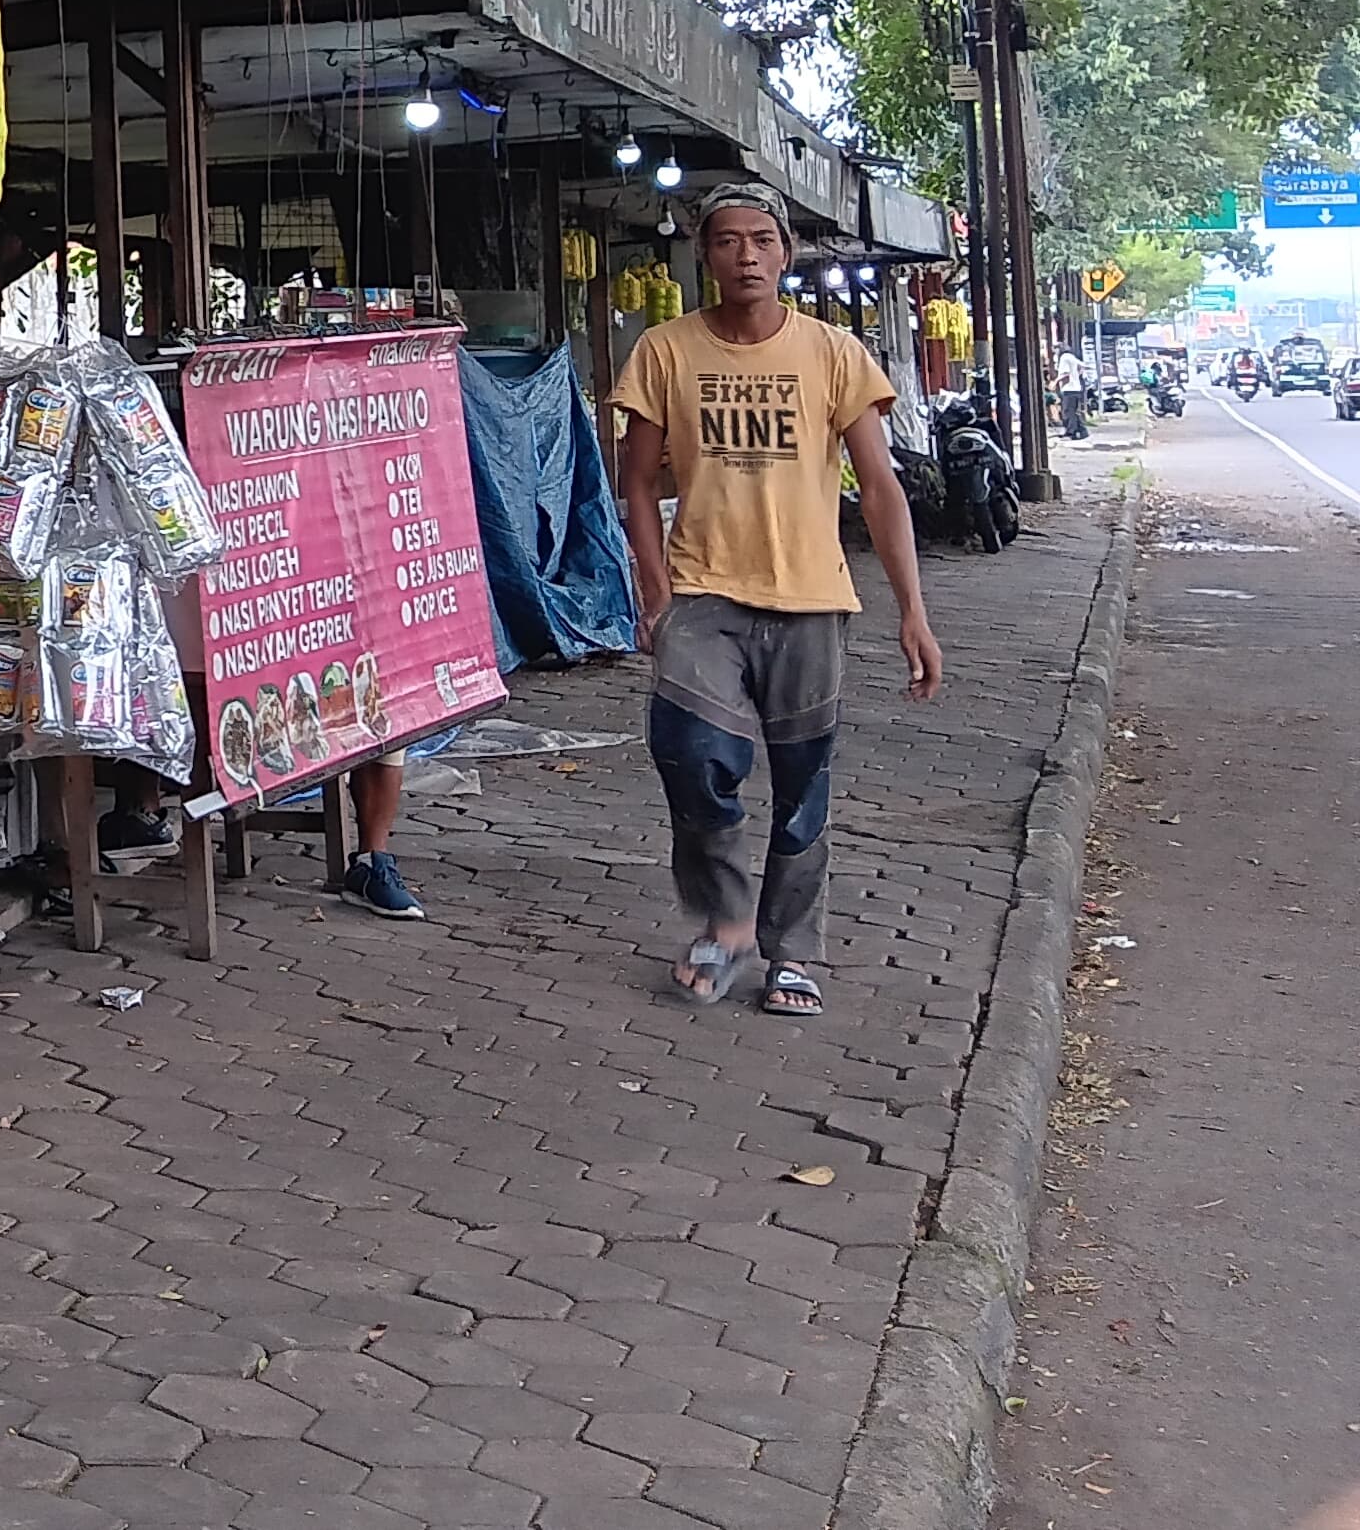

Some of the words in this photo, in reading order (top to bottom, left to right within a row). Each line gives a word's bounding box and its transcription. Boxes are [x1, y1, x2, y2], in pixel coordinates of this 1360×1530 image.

[1273, 178, 1349, 193] Surabaya
[700, 382, 795, 404] SIXTY
[225, 402, 321, 458] WARUNG
[323, 394, 365, 442] NASI
[366, 390, 406, 435] PAK
[700, 407, 798, 449] NINE
[210, 480, 244, 515] NASI
[243, 469, 301, 508] RAWON
[404, 524, 421, 552] ES
[218, 557, 252, 594] NASI
[408, 560, 425, 589] ES
[446, 546, 480, 578] BUAH
[221, 598, 257, 637] NASI
[306, 573, 355, 612] TEMPE
[413, 592, 436, 624] POP
[436, 586, 459, 617] ICE
[224, 639, 261, 678] NASI
[298, 612, 355, 654] GEPREK
